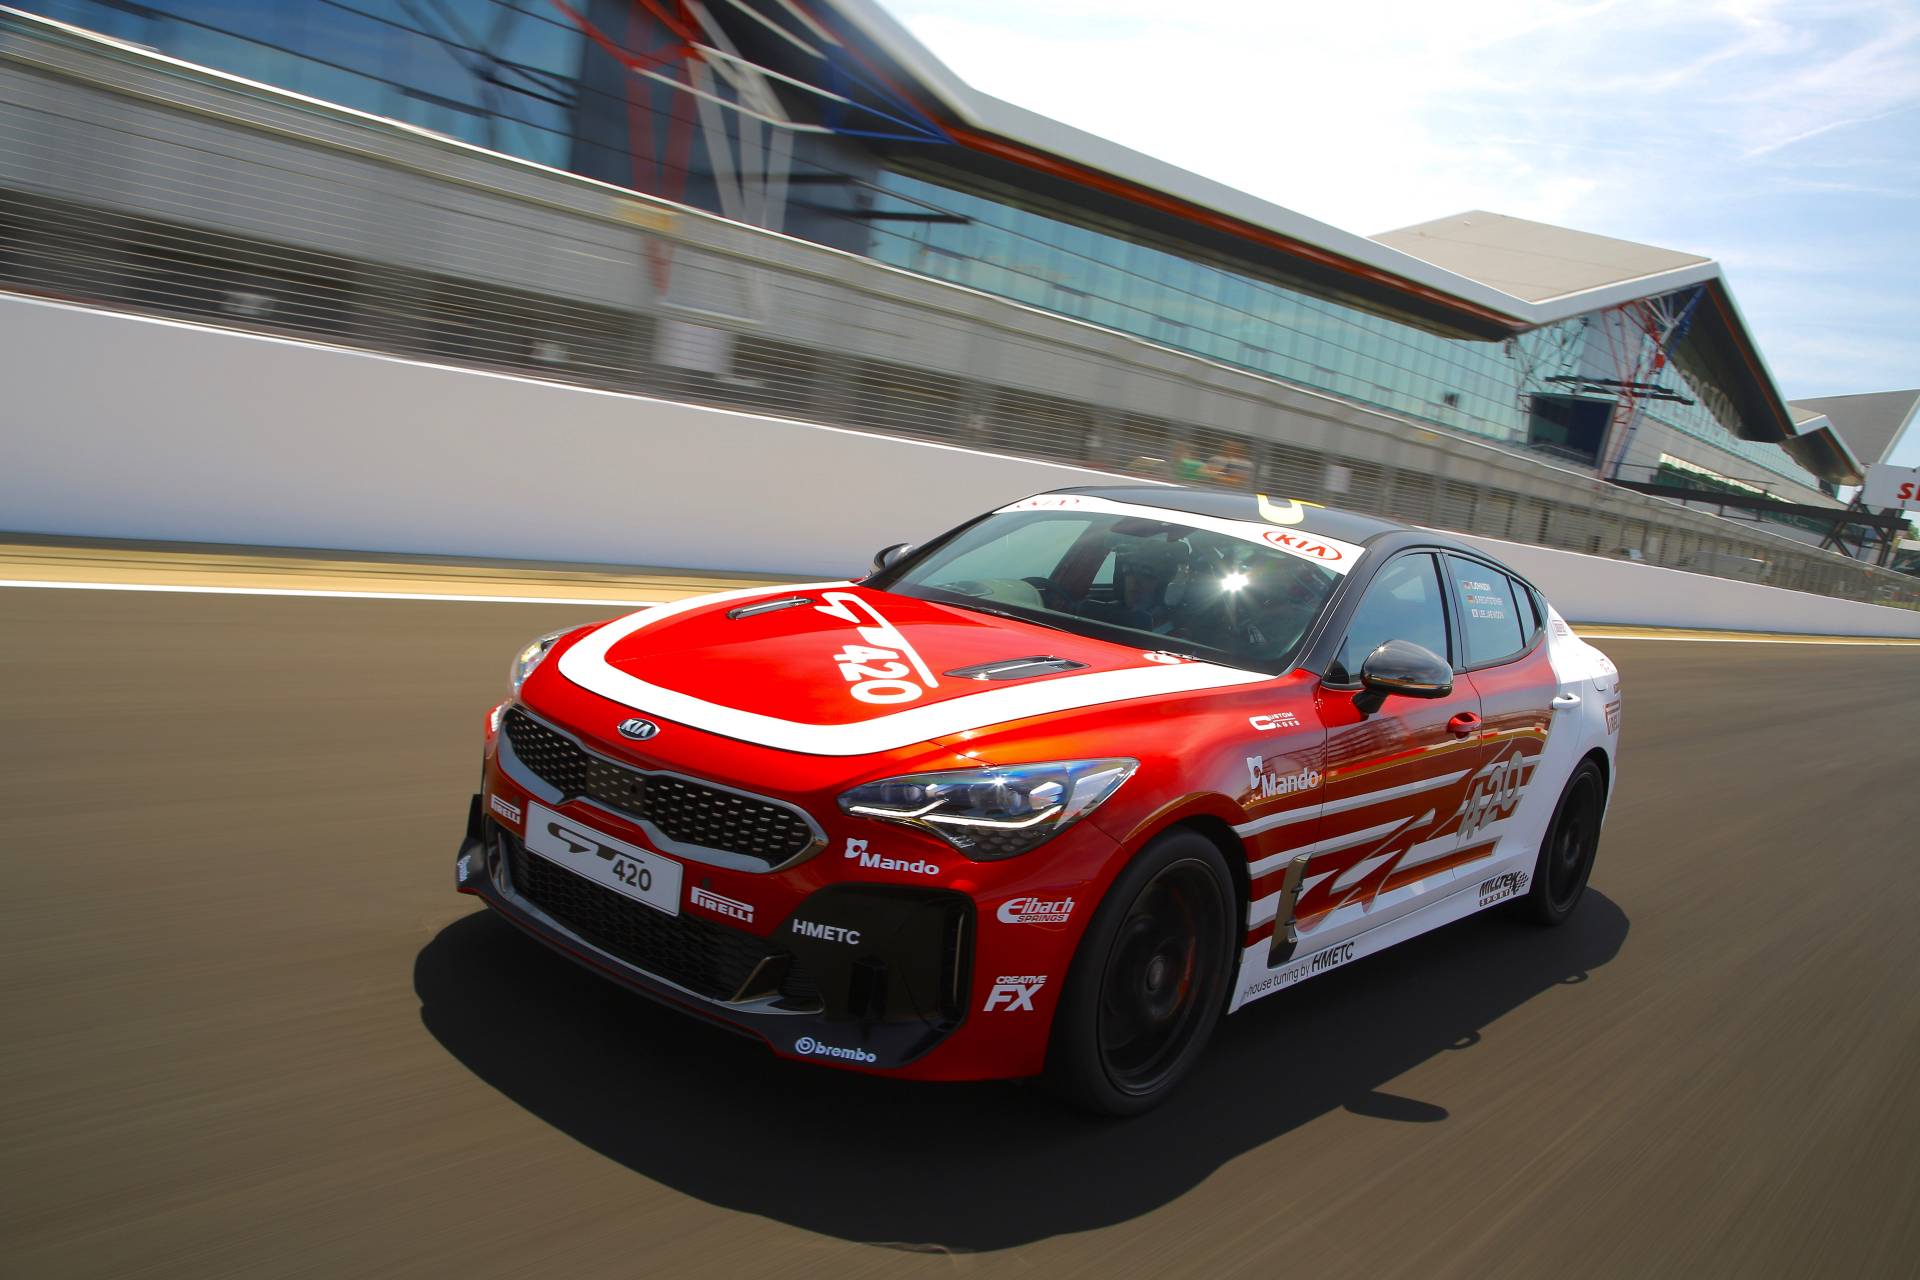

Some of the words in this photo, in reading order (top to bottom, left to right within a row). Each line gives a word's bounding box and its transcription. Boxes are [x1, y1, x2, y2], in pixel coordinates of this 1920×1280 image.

[1274, 533, 1327, 557] KIA
[833, 644, 923, 704] 420
[619, 719, 653, 737] KIA
[1261, 767, 1319, 799] Mando
[1456, 750, 1525, 840] 420
[612, 859, 652, 892] 420
[859, 852, 940, 876] Mando
[690, 886, 754, 924] PIRELLI
[996, 897, 1076, 924] Eibach
[1479, 889, 1511, 907] SPORT
[791, 918, 861, 945] HMETC
[1017, 914, 1065, 923] SPRINGS
[1273, 967, 1299, 987] tuning
[1300, 961, 1311, 978] by
[1311, 941, 1355, 973] HMETC
[996, 975, 1048, 985] CREATIVE
[983, 983, 1044, 1012] FX
[814, 1041, 877, 1064] brembo
